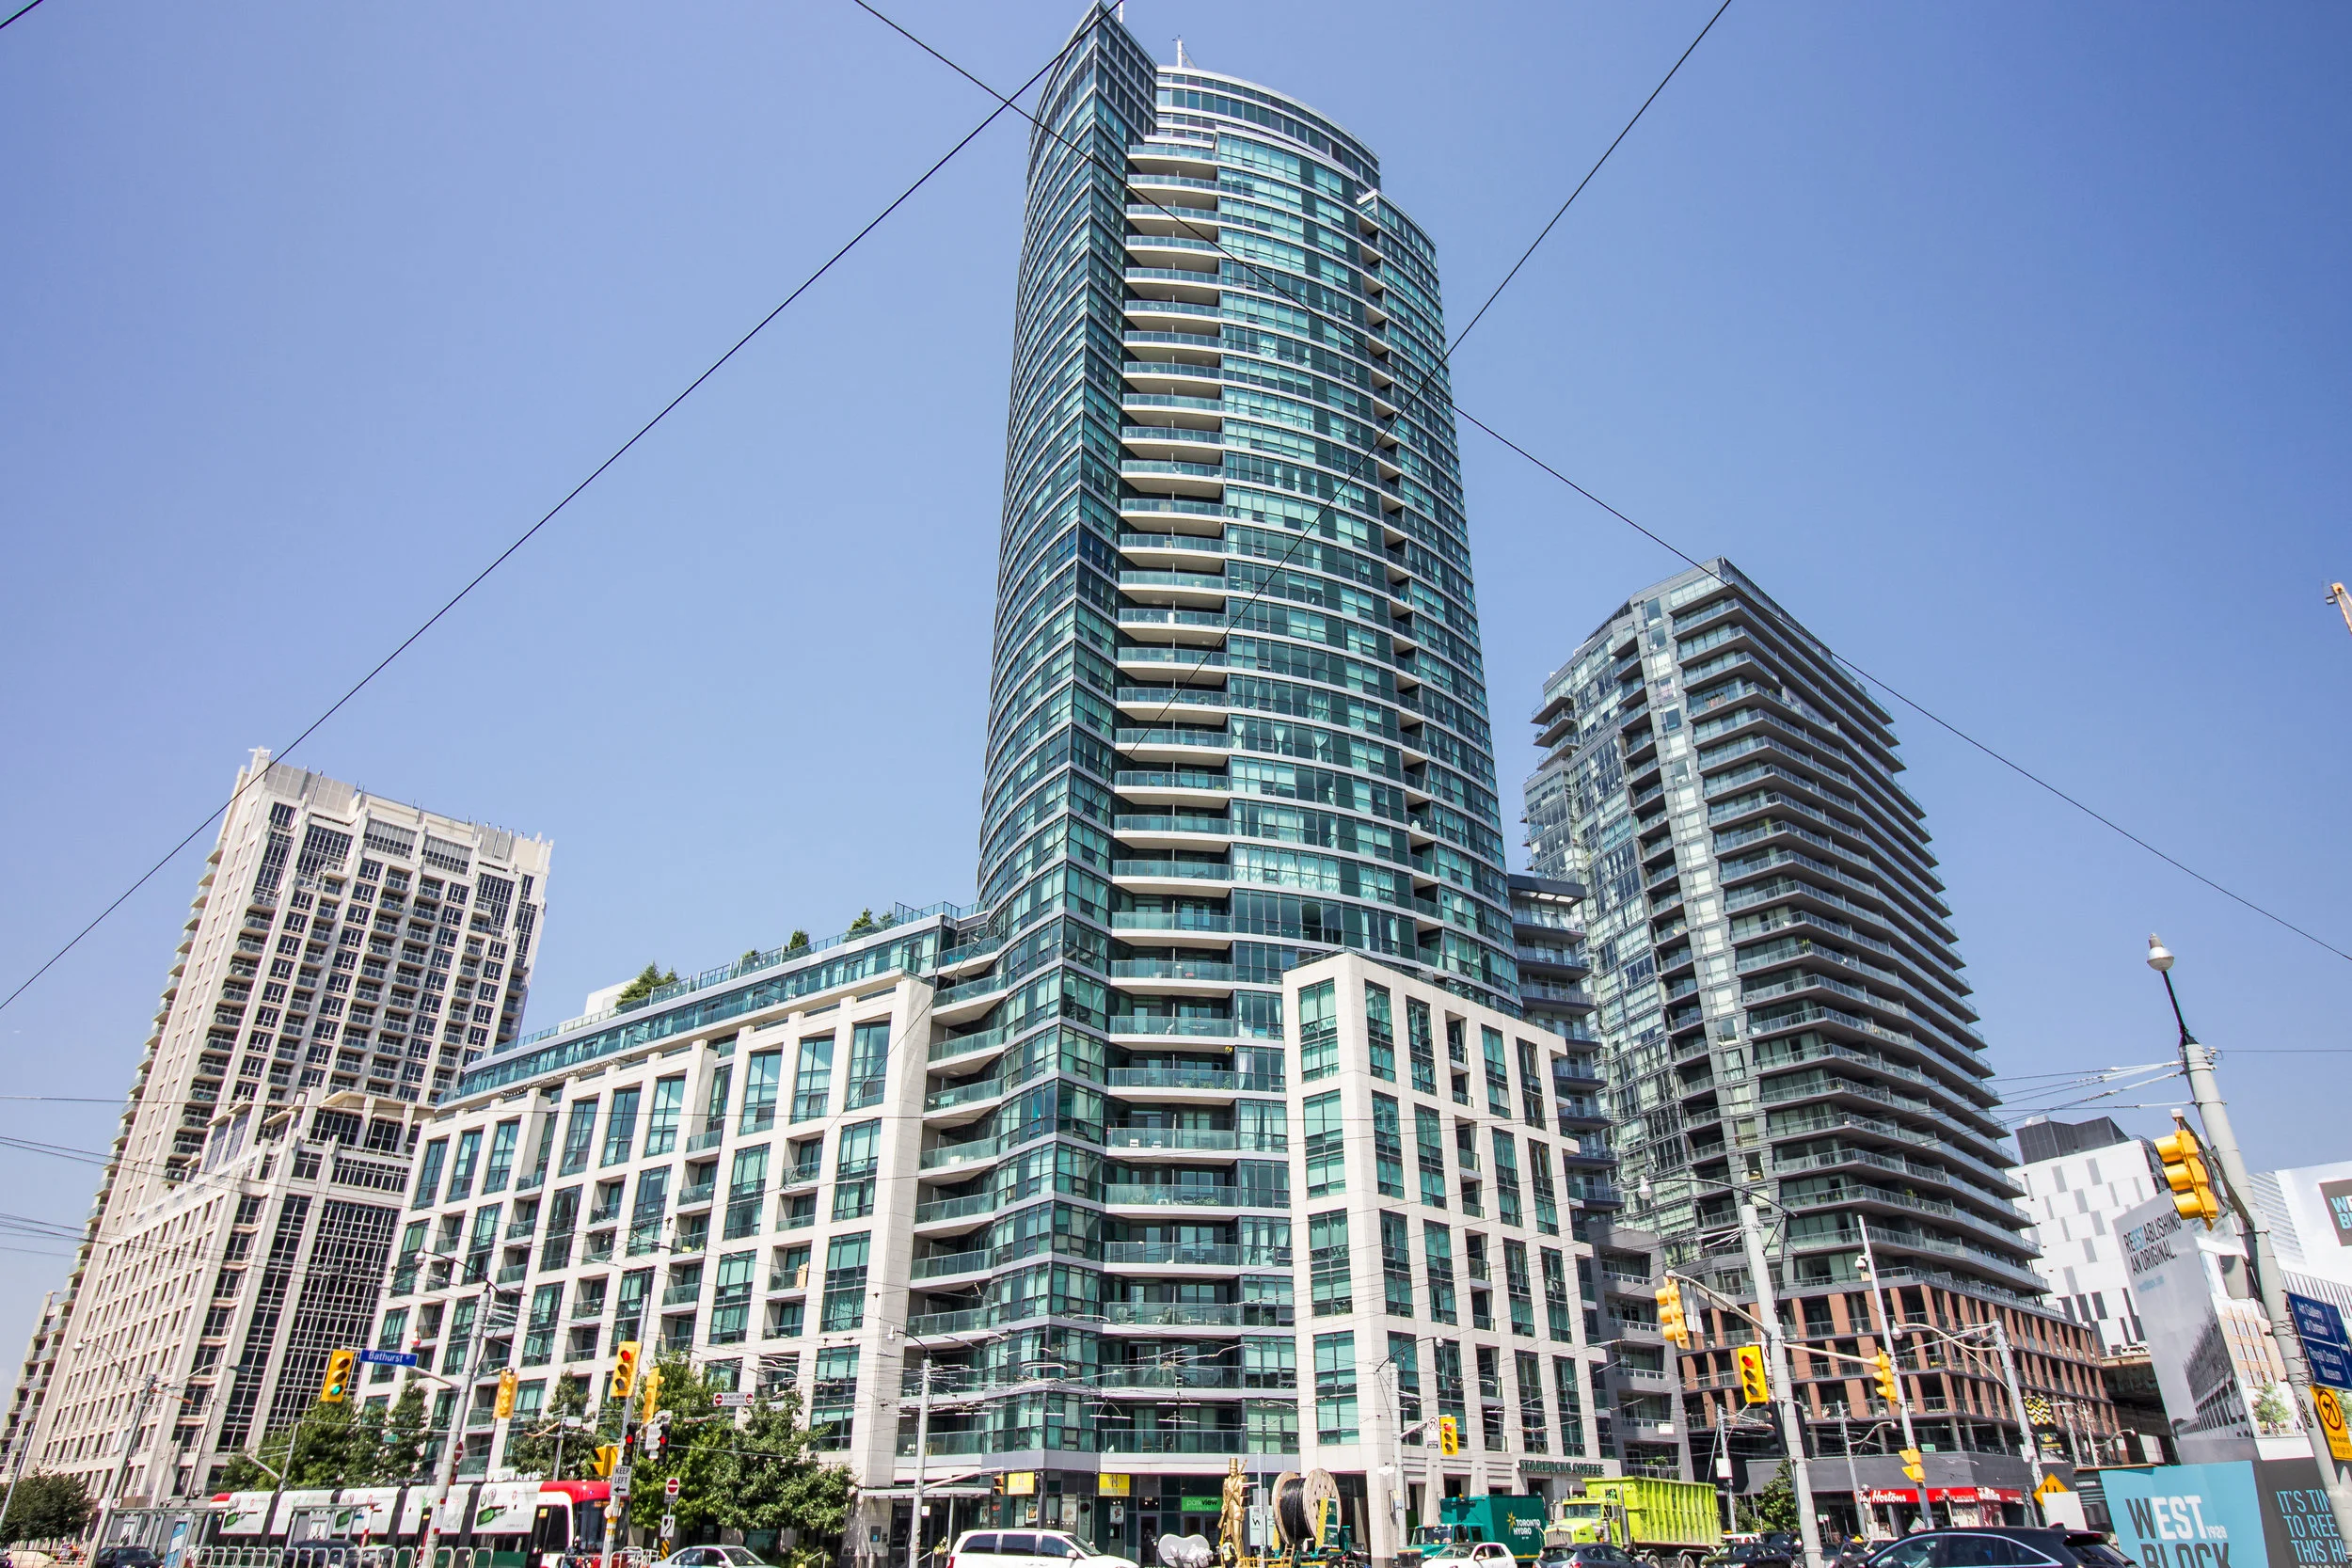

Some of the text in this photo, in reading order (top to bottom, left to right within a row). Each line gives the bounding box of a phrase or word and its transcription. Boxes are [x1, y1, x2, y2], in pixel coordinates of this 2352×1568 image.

[2122, 1209, 2182, 1254] REESTABLISHING
[2130, 1240, 2177, 1275] AN ORIGINAL.
[368, 1351, 404, 1363] Bathurst
[615, 1466, 630, 1475] KEEP
[1518, 1459, 1605, 1476] STARBUCKS COFFEE
[1186, 1498, 1218, 1507] parkview
[1872, 1489, 1907, 1503] Hortons
[2276, 1490, 2307, 1513] IT'S
[1516, 1518, 1541, 1528] TORONTO
[2124, 1495, 2207, 1540] WEST
[2283, 1514, 2306, 1538] TO
[1513, 1527, 1533, 1536] HYDRO
[2140, 1542, 2232, 1568] BLOCK
[2291, 1539, 2328, 1563] THIS
